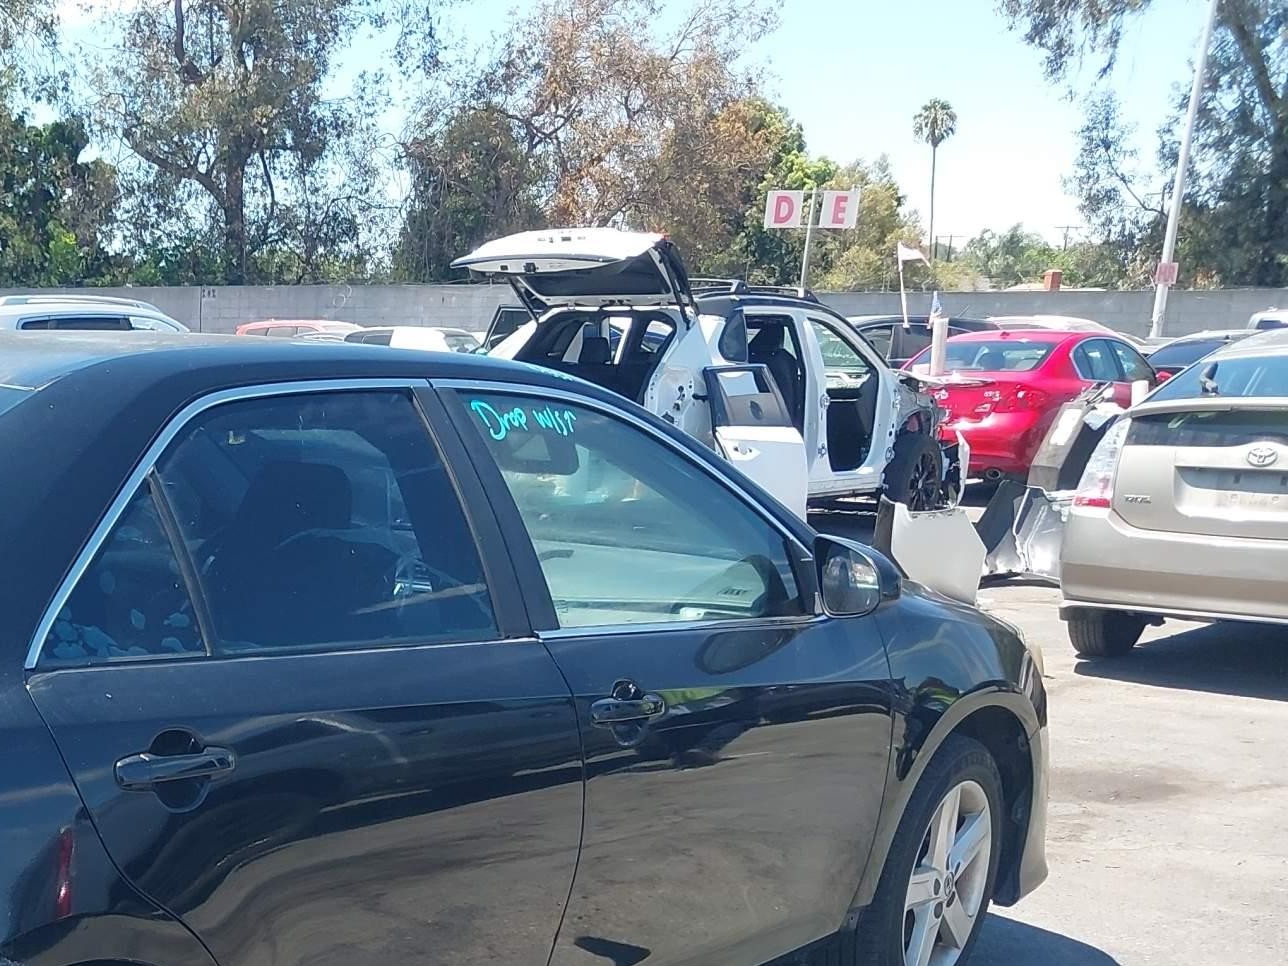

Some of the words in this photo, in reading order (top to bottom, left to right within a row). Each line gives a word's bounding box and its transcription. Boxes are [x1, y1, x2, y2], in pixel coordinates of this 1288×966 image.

[773, 196, 794, 224] D
[832, 196, 849, 224] E
[470, 400, 528, 440] Drop
